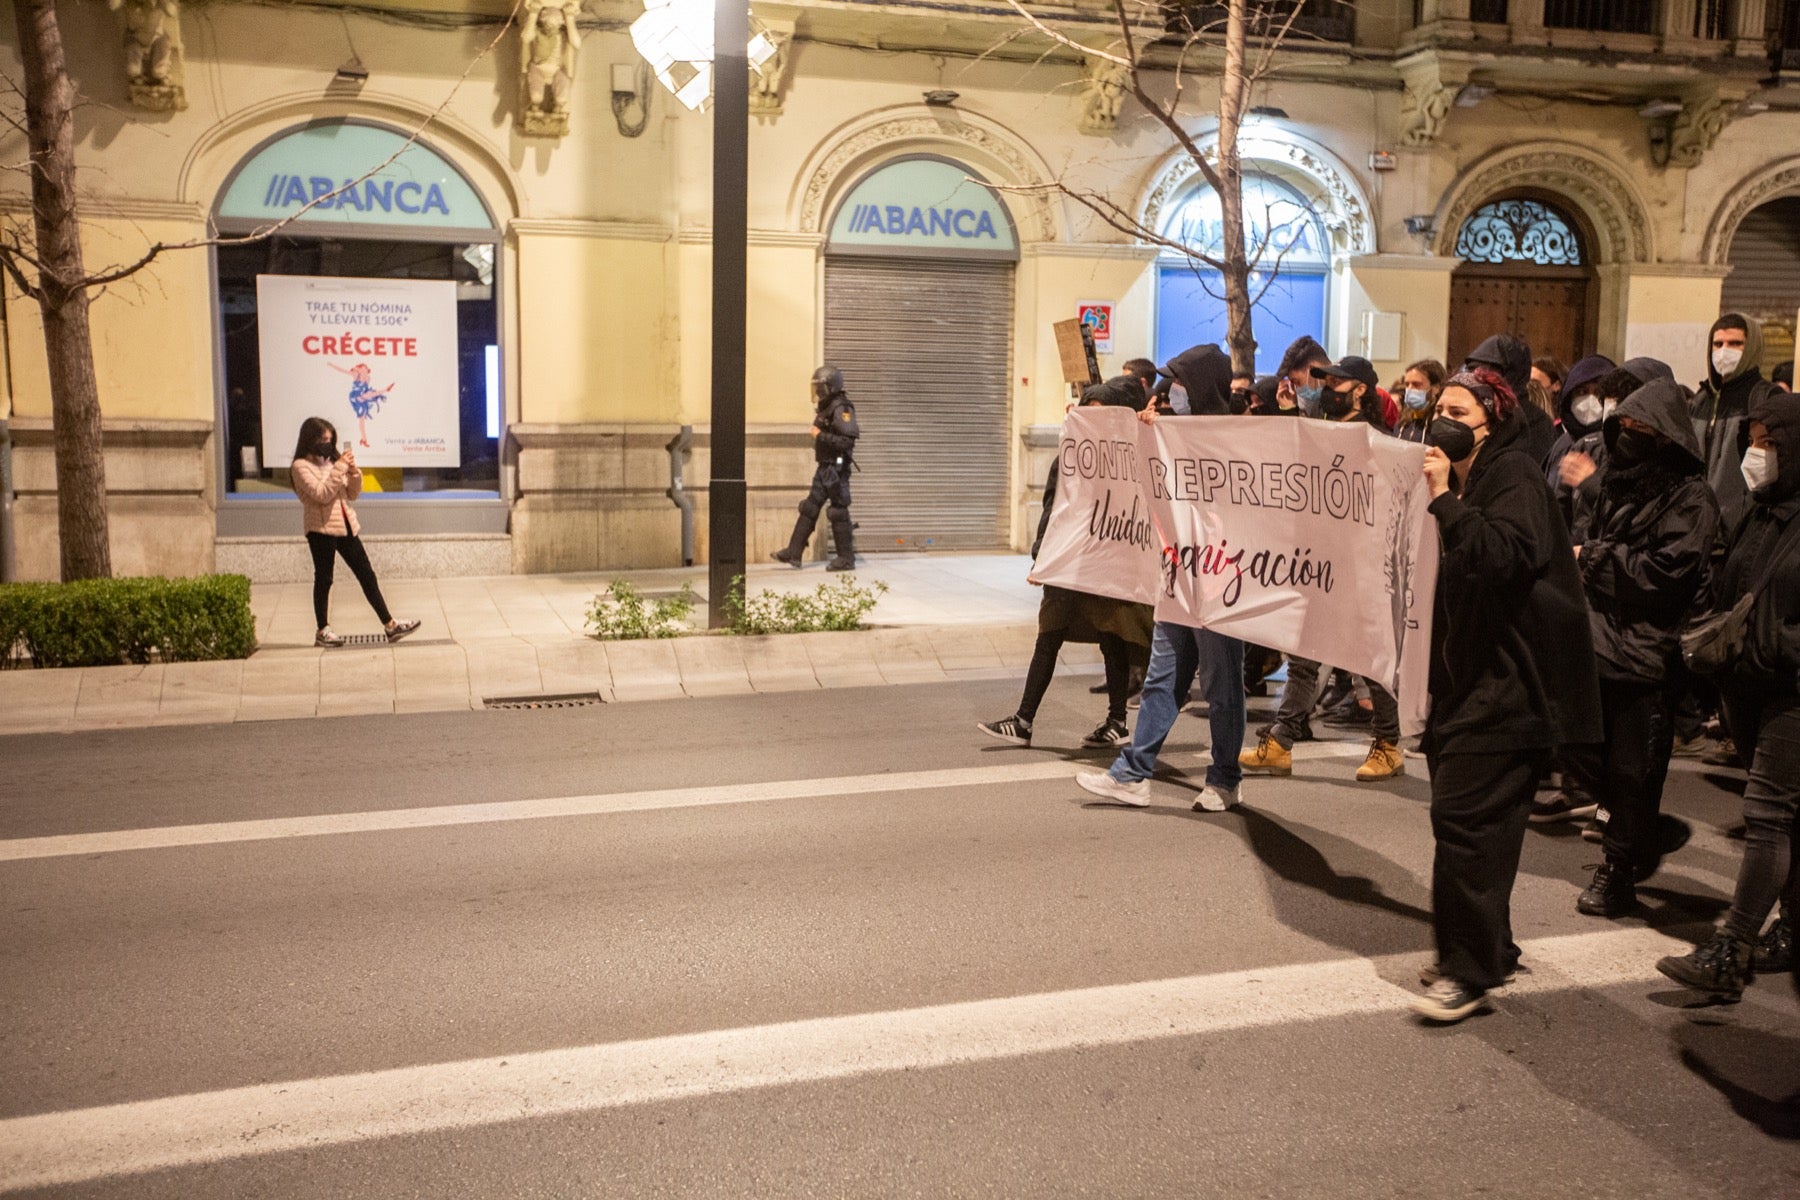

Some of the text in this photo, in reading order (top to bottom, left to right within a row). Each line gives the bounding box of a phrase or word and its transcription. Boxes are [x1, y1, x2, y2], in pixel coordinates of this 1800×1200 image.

[305, 301, 412, 314] TRAE TU NÓMINA
[309, 313, 317, 324] Y
[321, 312, 371, 325] LLÉVATE
[302, 331, 418, 357] CRÉCETE
[1060, 438, 1375, 527] CONTR REPRESIÓN
